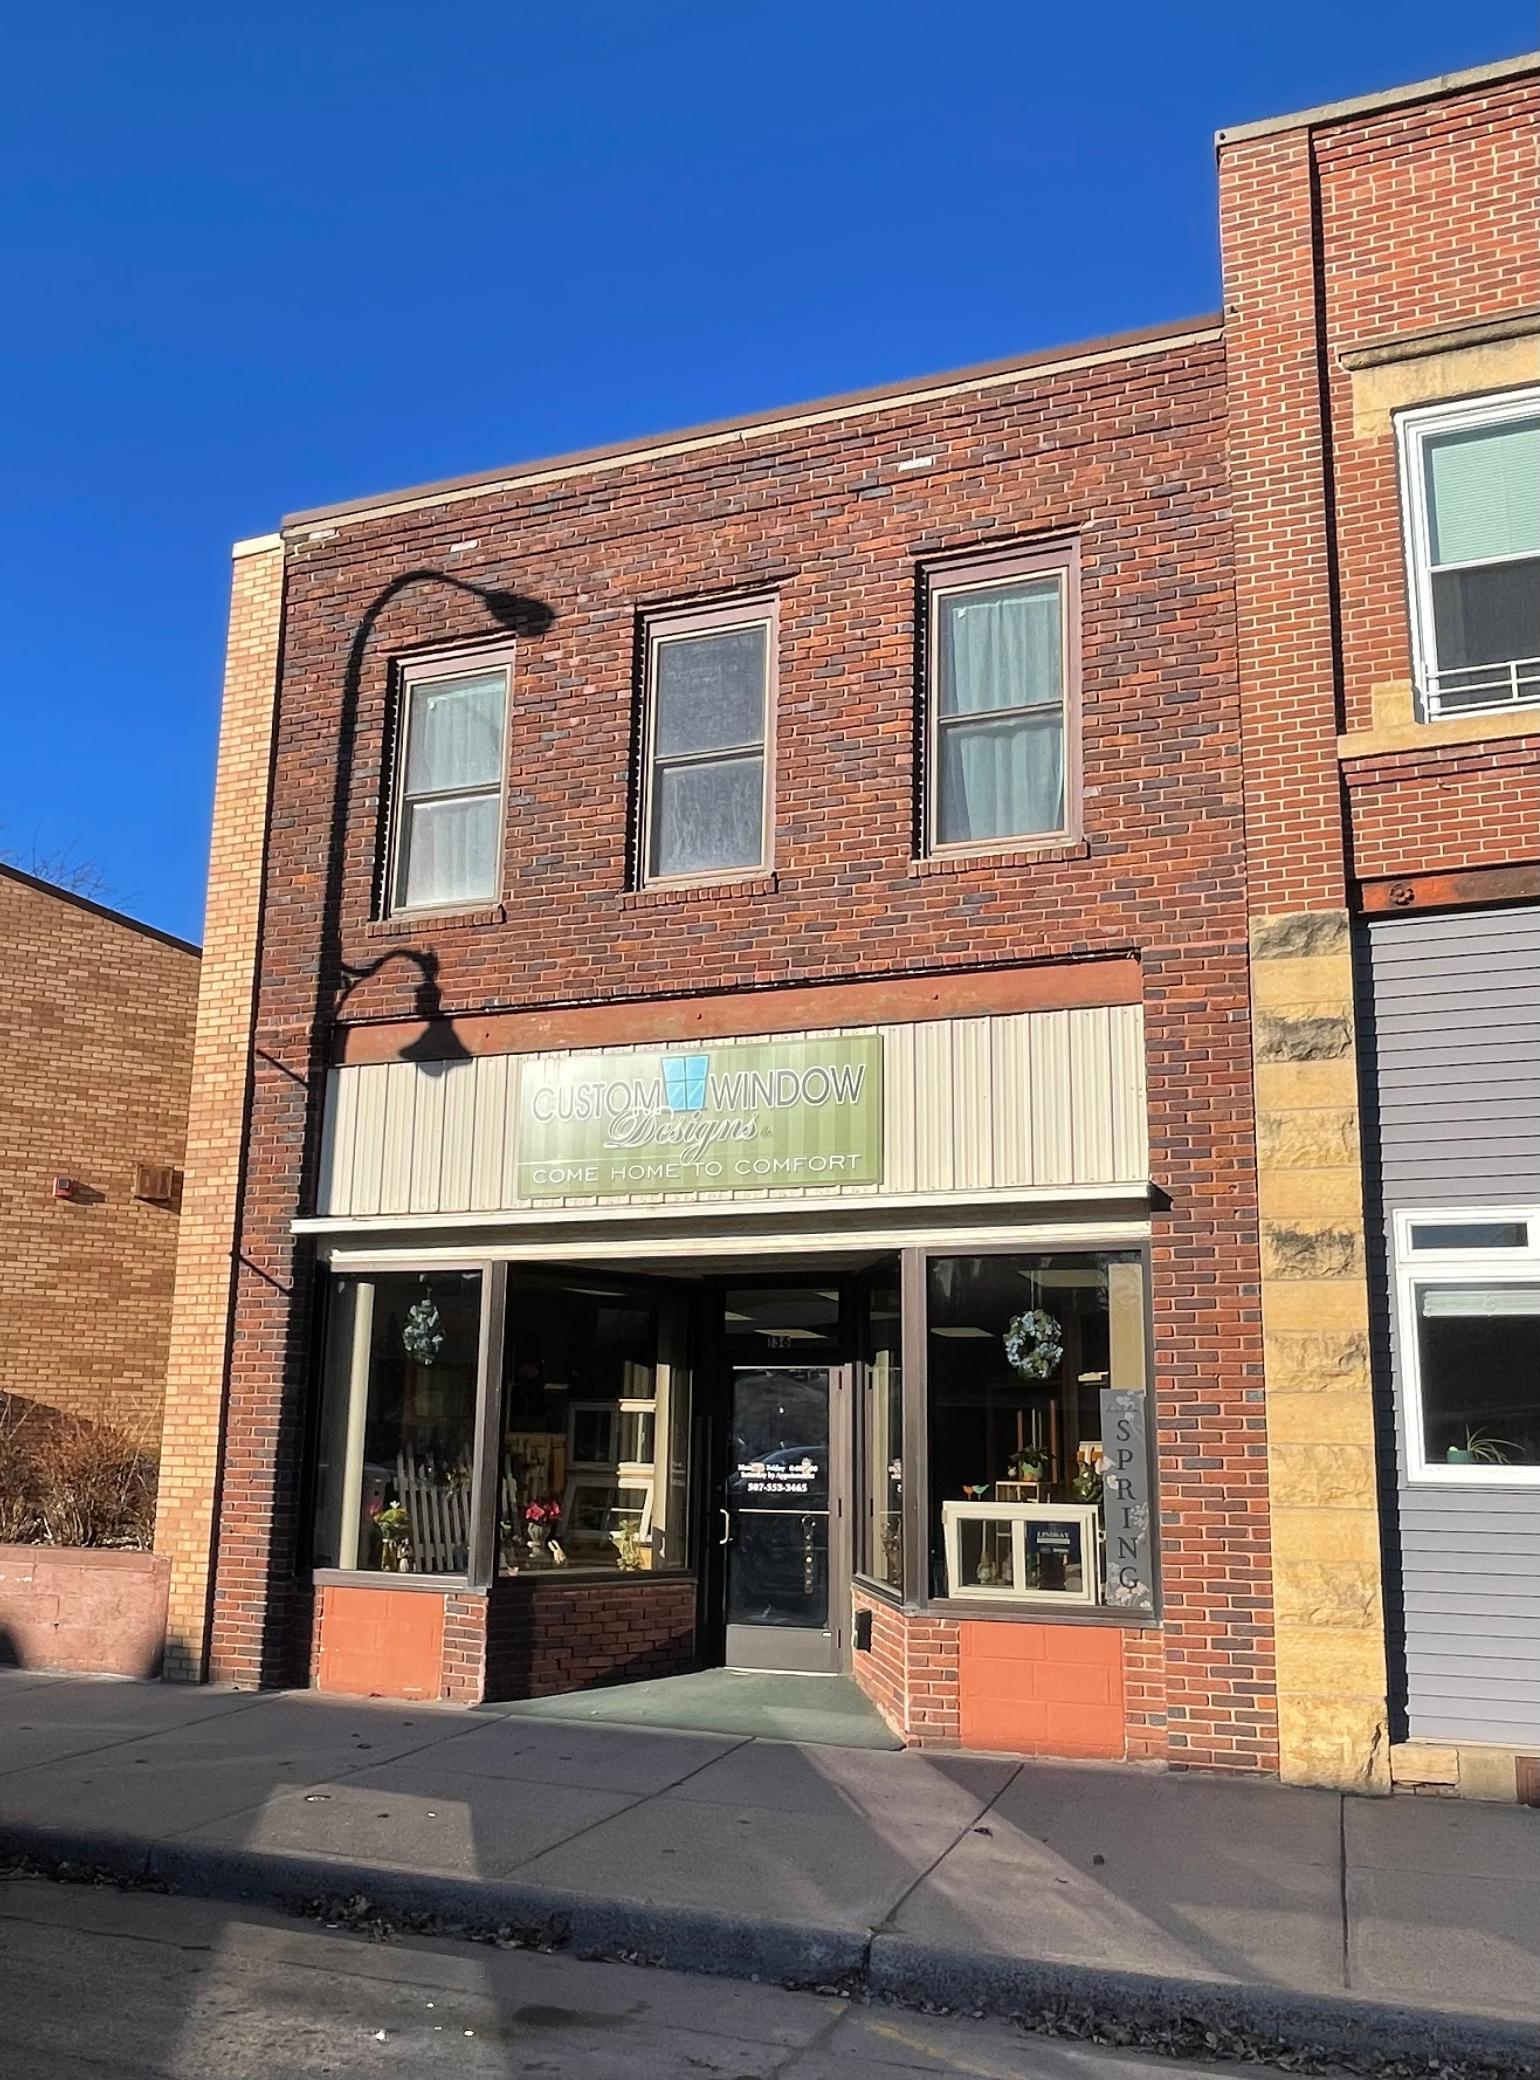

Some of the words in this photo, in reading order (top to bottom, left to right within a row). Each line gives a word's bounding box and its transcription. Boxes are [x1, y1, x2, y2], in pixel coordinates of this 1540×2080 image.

[532, 1078, 662, 1123] CUSTOM
[709, 1064, 866, 1111] WINDOW
[603, 1105, 758, 1166] Designs
[532, 1167, 600, 1183] COME
[611, 1163, 681, 1180] HOME
[691, 1160, 722, 1177] TO
[735, 1154, 861, 1175] COMFORT
[1116, 1419, 1139, 1589] SPRING
